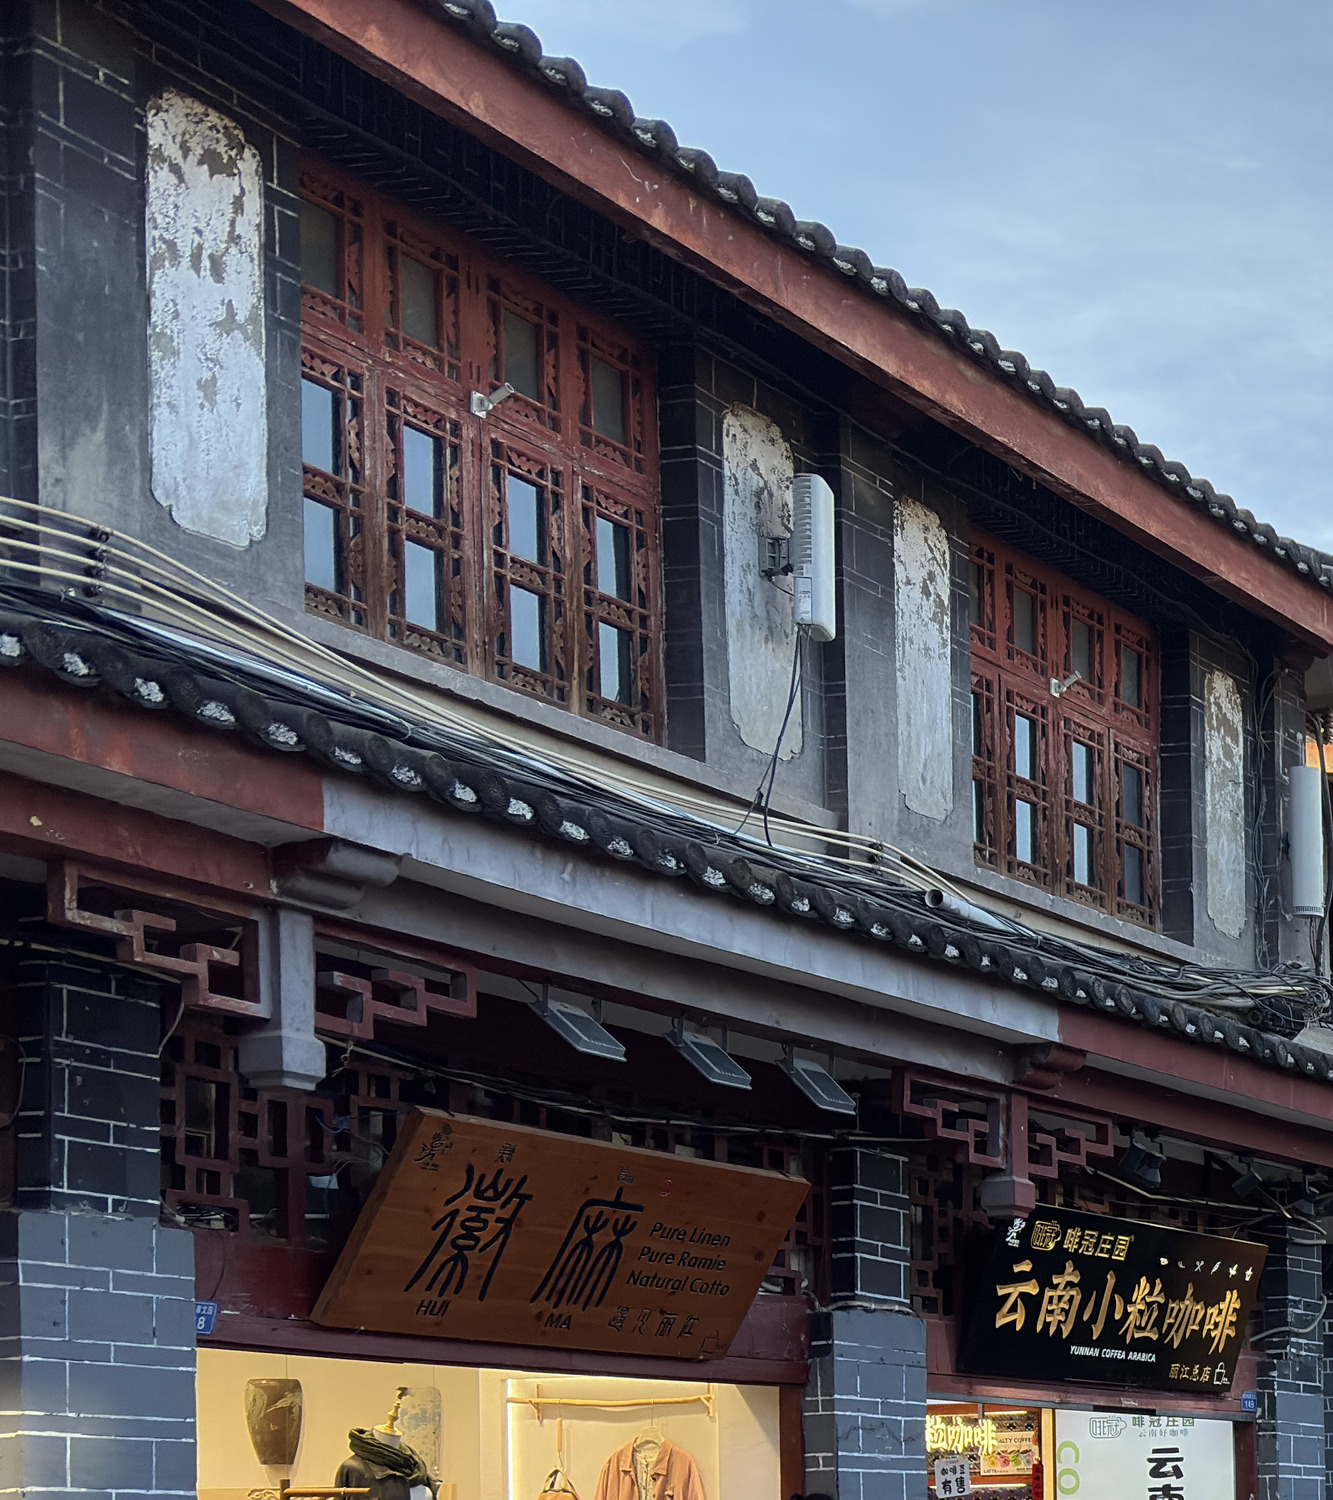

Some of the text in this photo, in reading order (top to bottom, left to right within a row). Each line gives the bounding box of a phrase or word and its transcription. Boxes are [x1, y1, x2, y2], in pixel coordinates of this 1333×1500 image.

[650, 1222, 731, 1248] Pure Linen
[1063, 1228, 1131, 1261] 啡冠庄园
[637, 1246, 727, 1271] Pure Ramie
[626, 1270, 688, 1292] Natural
[416, 1300, 572, 1330] HUI MA
[995, 1259, 1241, 1355] 云南小粒咖啡
[1070, 1345, 1156, 1362] YUNNAN COFFEA ARABICA
[941, 1476, 966, 1494] 有售
